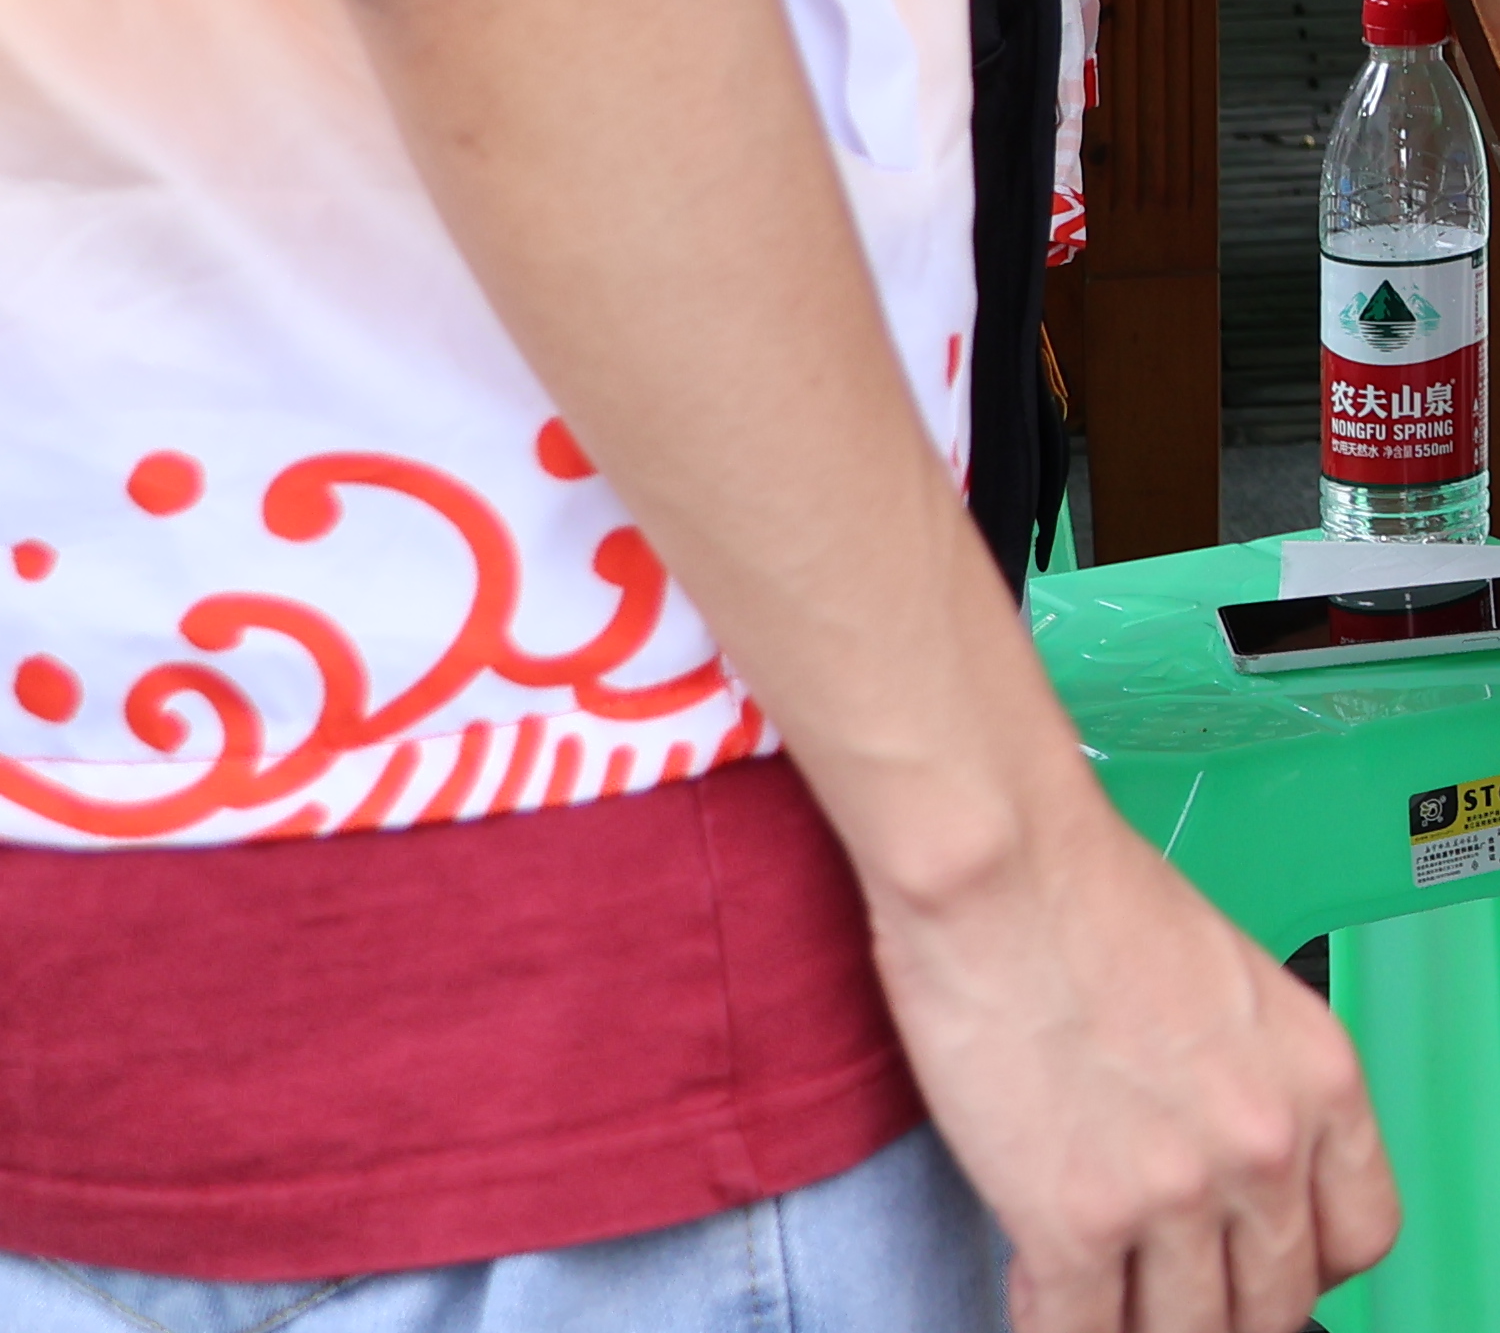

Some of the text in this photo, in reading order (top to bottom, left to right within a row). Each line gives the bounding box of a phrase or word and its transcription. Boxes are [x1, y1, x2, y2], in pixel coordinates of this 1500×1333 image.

[1331, 380, 1454, 420] 农夫山泉
[1331, 419, 1454, 441] NONGFU SPRING
